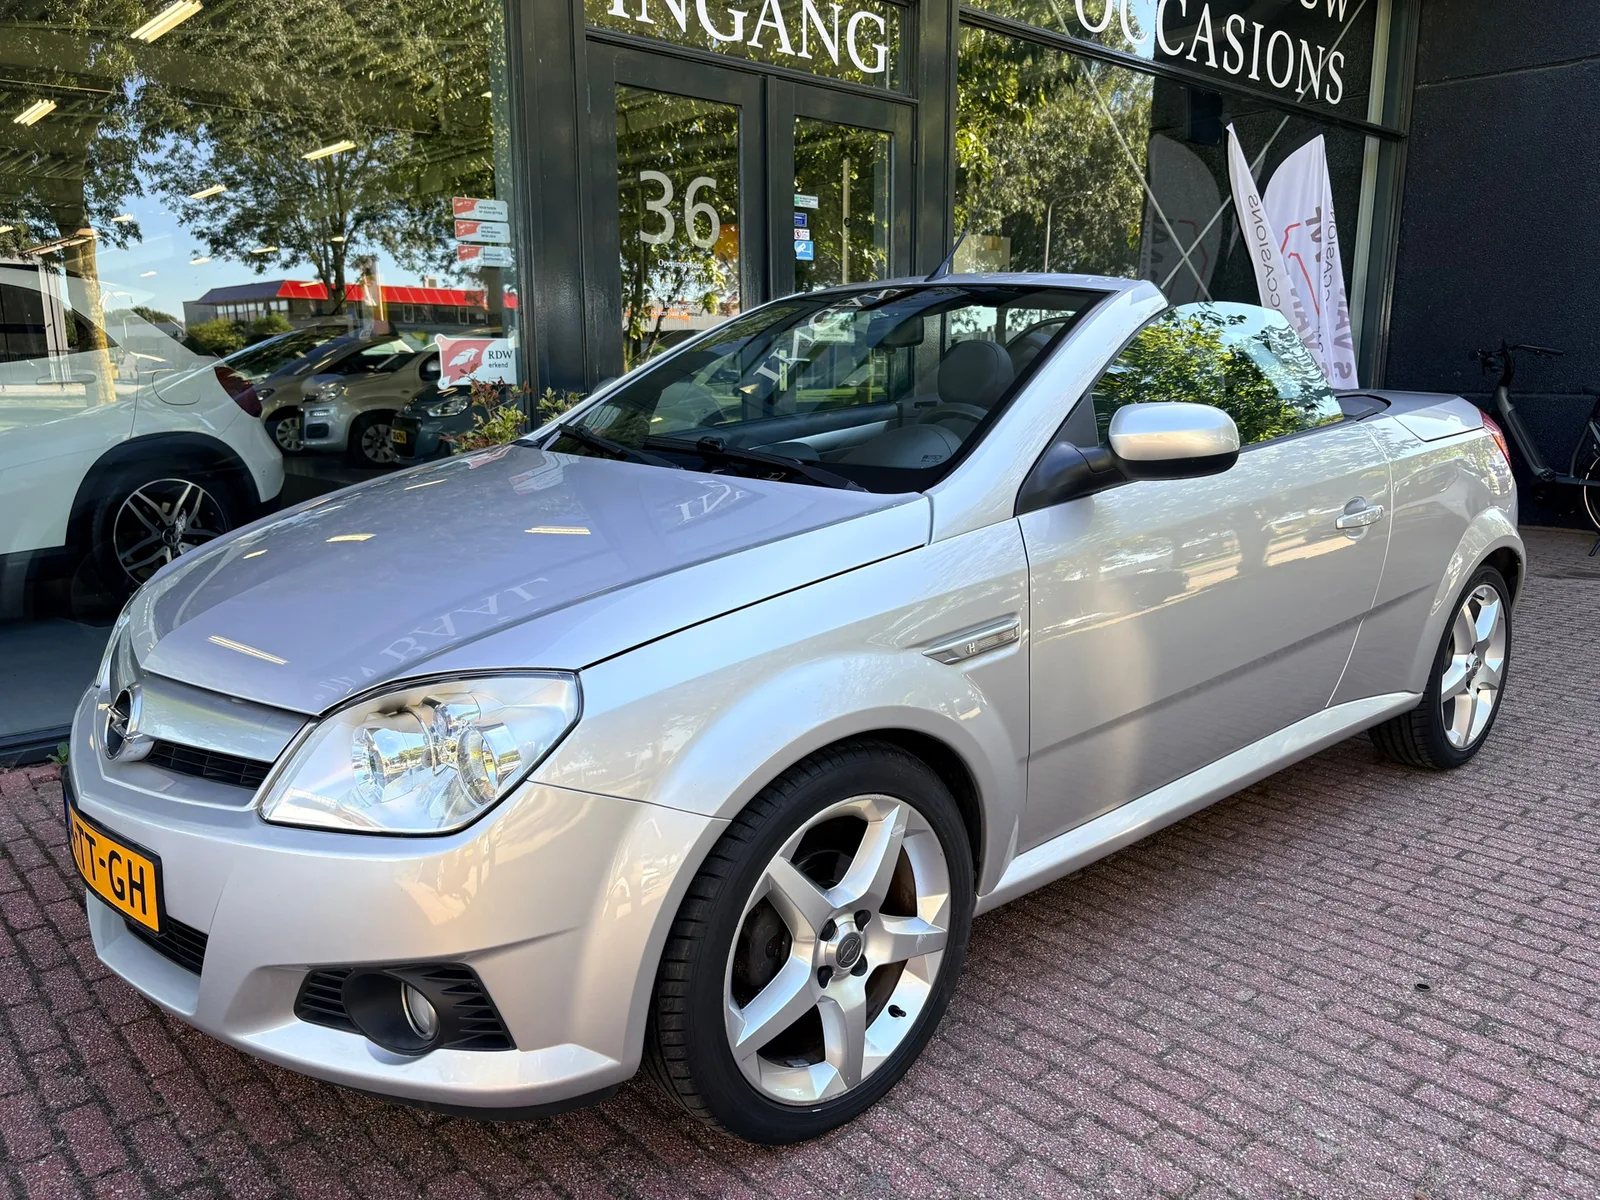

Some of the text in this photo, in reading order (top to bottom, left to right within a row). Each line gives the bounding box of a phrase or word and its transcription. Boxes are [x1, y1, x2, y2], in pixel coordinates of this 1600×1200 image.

[607, 0, 889, 74] GANG
[639, 170, 721, 250] 36
[488, 350, 513, 360] RDW
